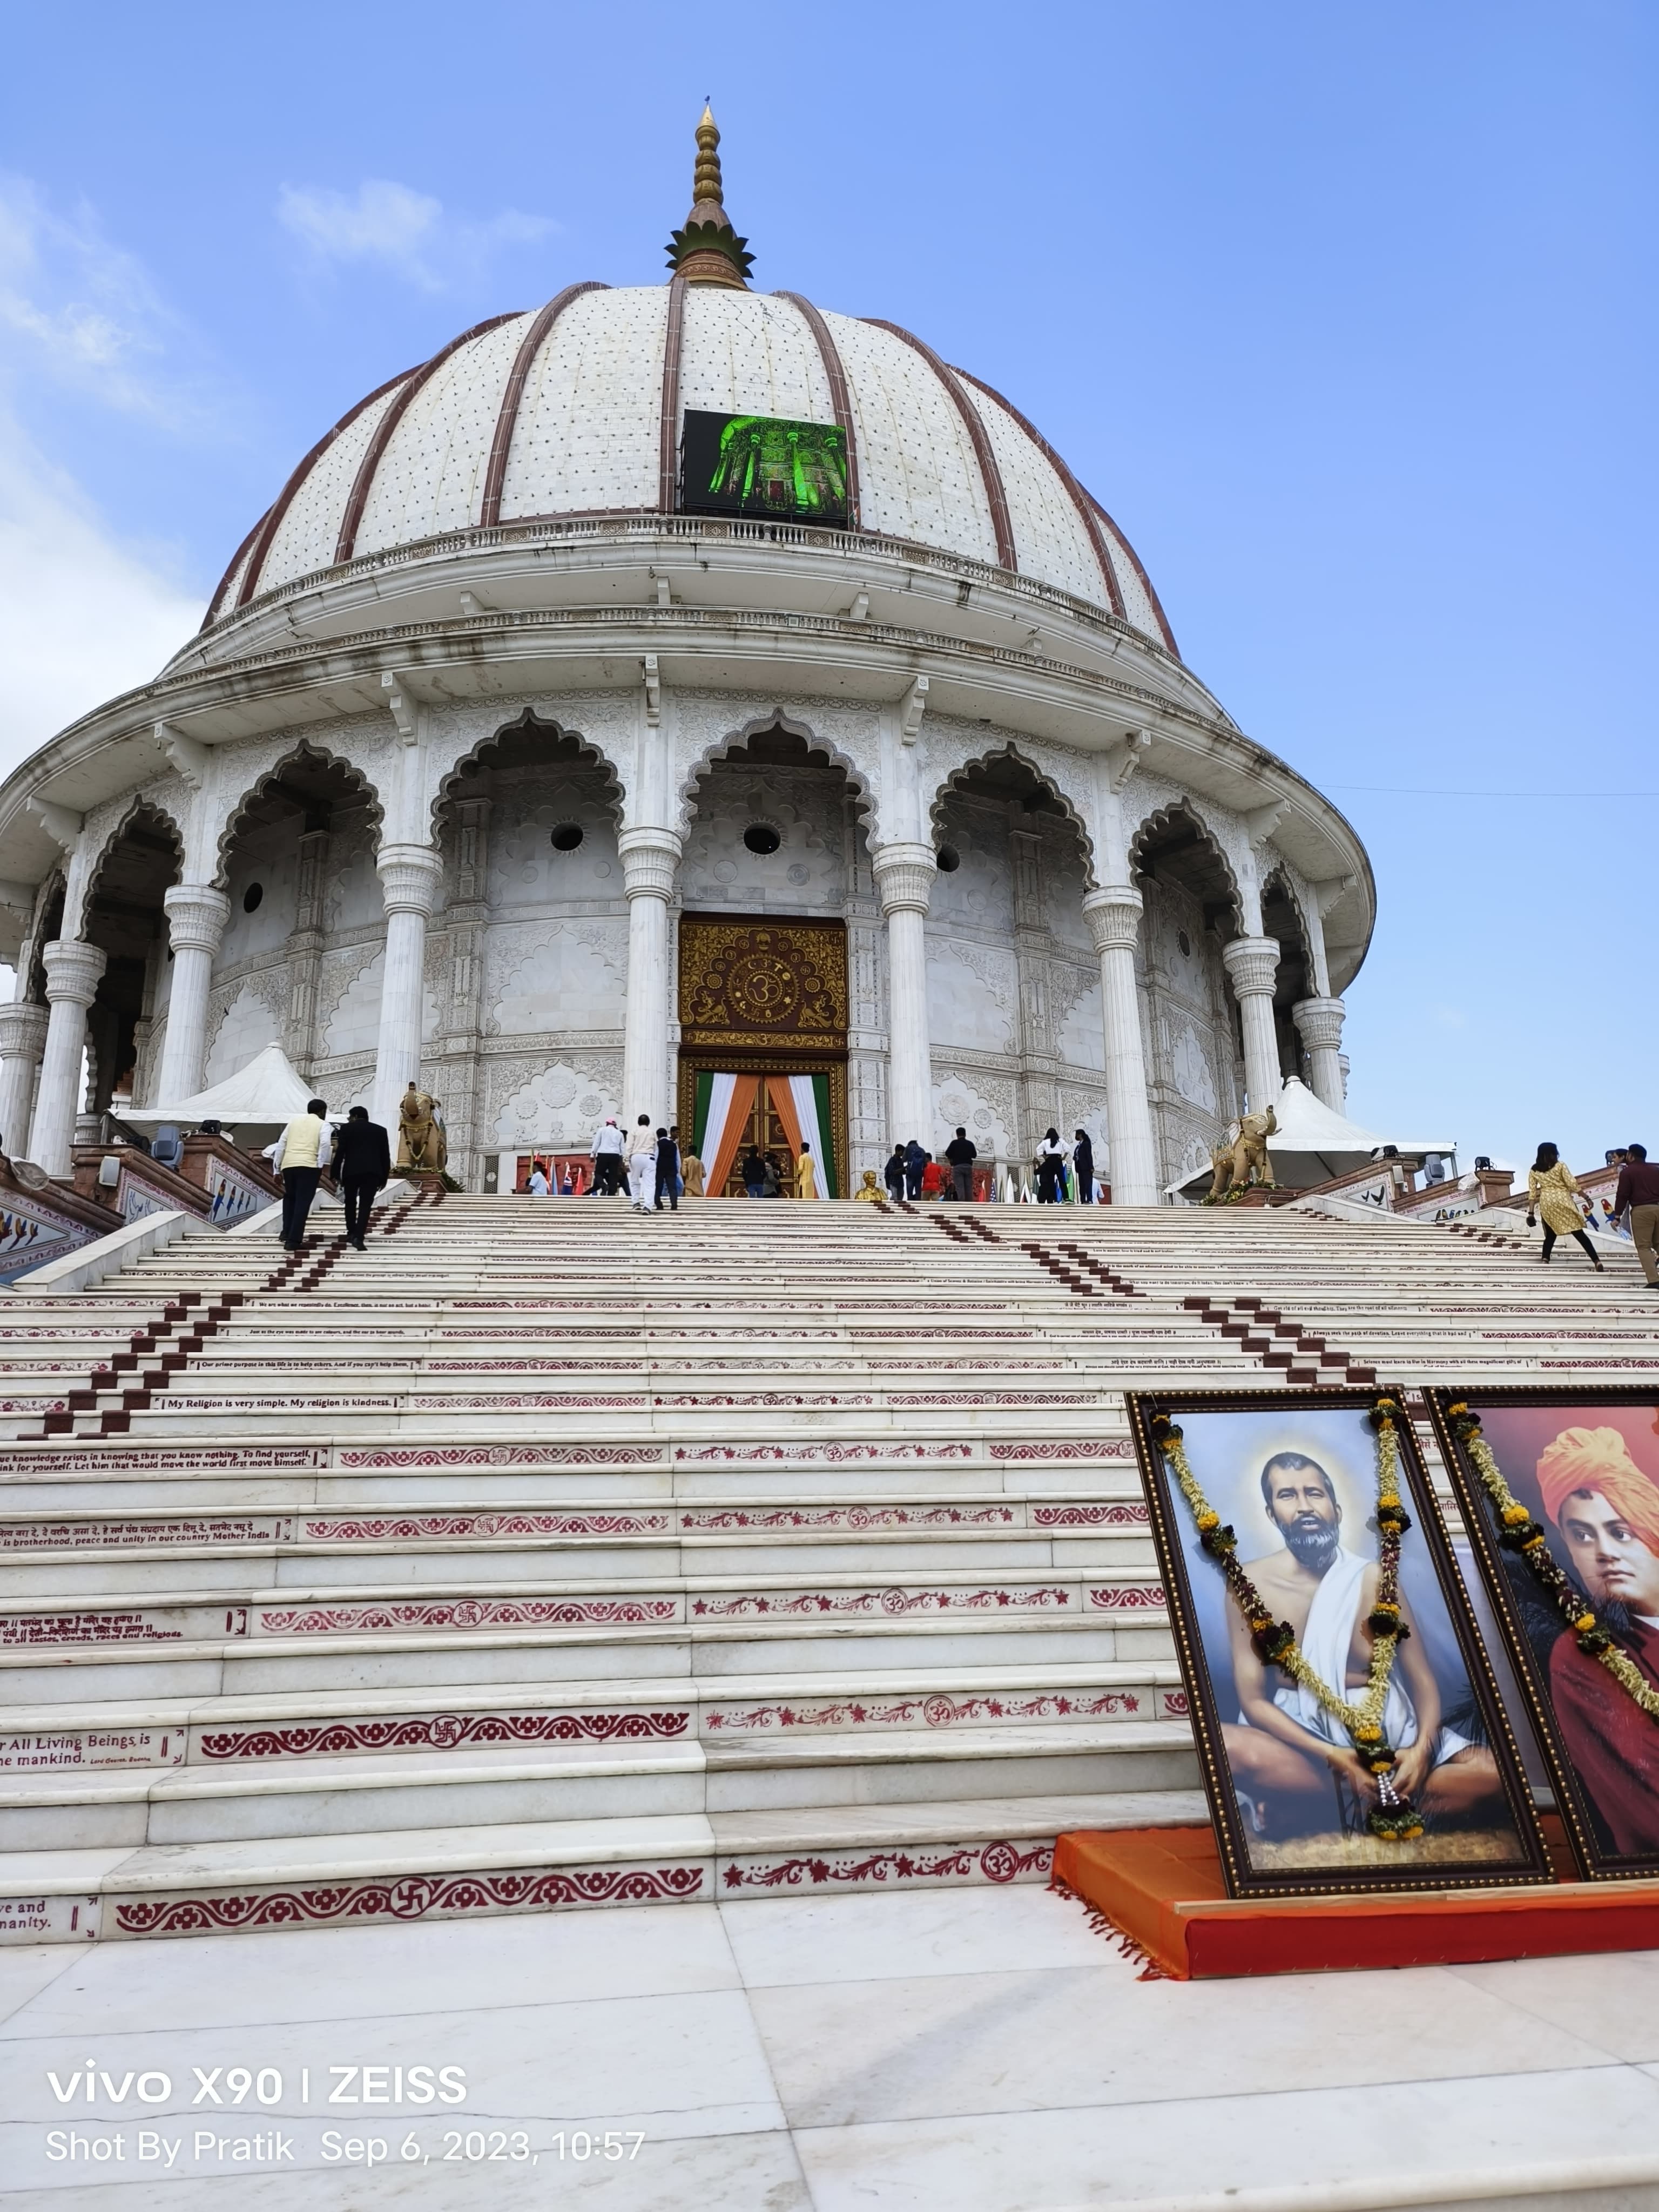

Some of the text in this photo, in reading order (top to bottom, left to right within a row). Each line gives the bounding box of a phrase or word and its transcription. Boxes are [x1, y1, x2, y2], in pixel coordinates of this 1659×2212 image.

[168, 1398, 391, 1410] My Religion is very simple. My religion is kindness.
[12, 1454, 60, 1464] knowledge
[63, 1454, 87, 1462] exists
[90, 1453, 98, 1461] in
[101, 1452, 139, 1462] knowing
[140, 1452, 159, 1460] that
[160, 1453, 177, 1461] you
[242, 1450, 253, 1458] To
[255, 1449, 272, 1458] find
[17, 1464, 30, 1472] for
[32, 1462, 72, 1473] yourself.
[75, 1462, 89, 1471] Let
[111, 1461, 129, 1469] that
[202, 1459, 227, 1467] world
[230, 1459, 247, 1467] first
[13, 1537, 73, 1547] brotherhood,
[76, 1537, 101, 1546] peace
[103, 1535, 120, 1543] and
[123, 1535, 145, 1543] unity
[148, 1534, 156, 1542] in
[176, 1534, 211, 1542] country
[213, 1531, 245, 1540] Mother
[247, 1530, 270, 1539] India
[9, 1738, 31, 1751] All
[35, 1737, 82, 1752] Living
[88, 1734, 137, 1750] Beings,
[139, 1732, 151, 1745] is
[17, 1751, 85, 1766] mankind.
[17, 1900, 45, 1914] and
